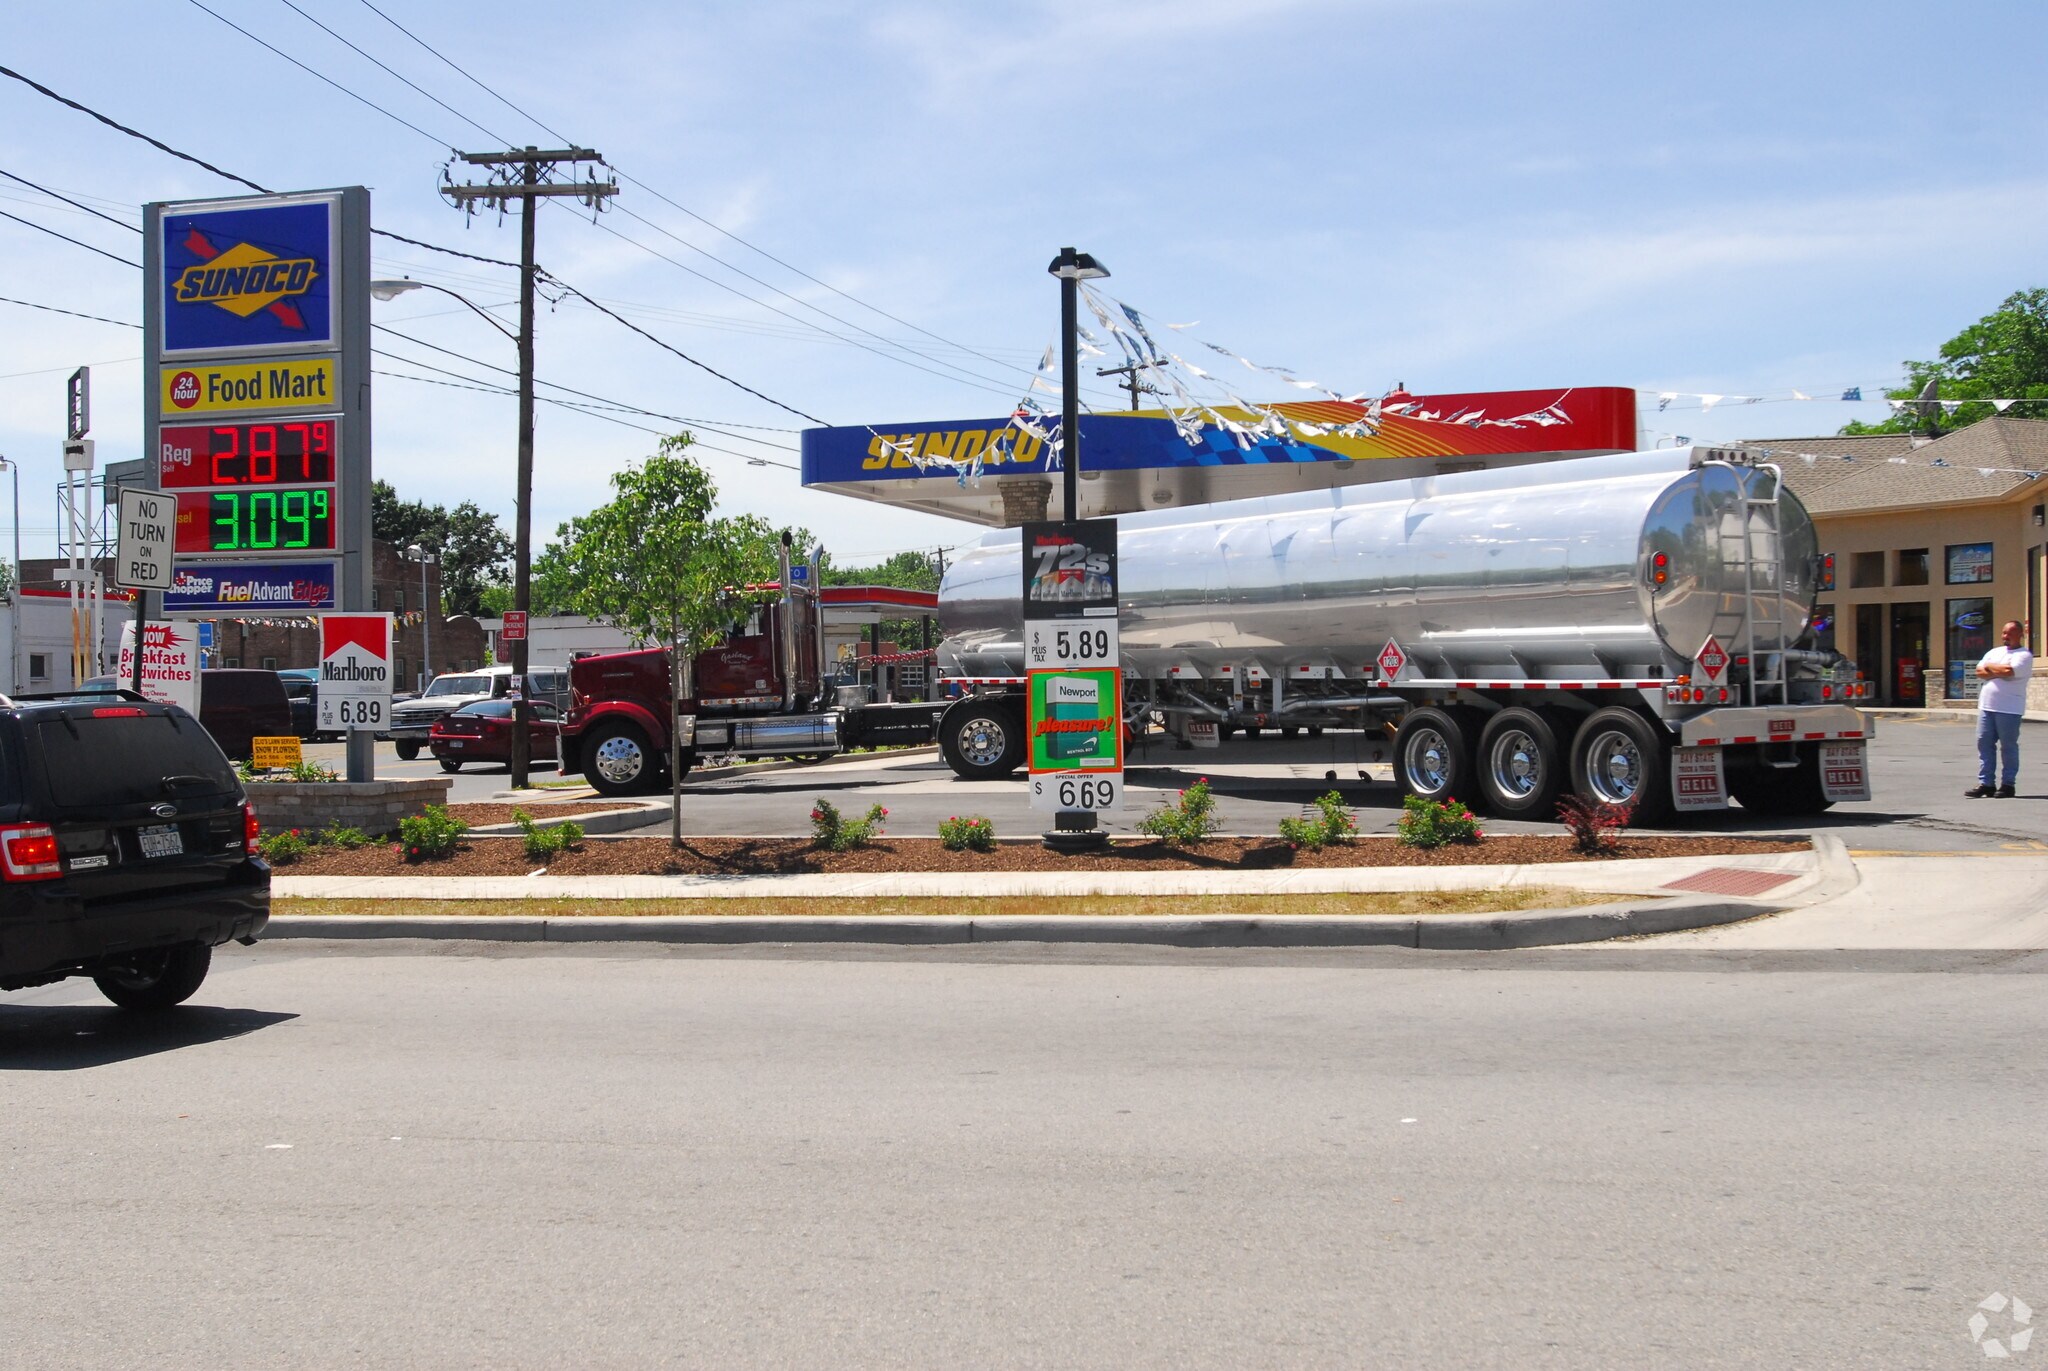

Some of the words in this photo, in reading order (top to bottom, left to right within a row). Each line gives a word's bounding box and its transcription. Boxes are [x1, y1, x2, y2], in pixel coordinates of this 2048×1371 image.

[180, 262, 312, 299] SUNOCO
[179, 377, 193, 389] 24
[208, 370, 262, 402] Food
[269, 367, 326, 399] Mart
[174, 387, 198, 400] hour
[162, 444, 192, 467] Reg
[862, 427, 1043, 470] SUNOCO
[138, 500, 158, 519] NO
[176, 511, 192, 524] sel
[129, 522, 166, 543] TURN
[139, 546, 152, 558] ON
[1032, 543, 1110, 578] 72's
[130, 561, 158, 581] RED
[186, 576, 213, 586] Price
[1033, 632, 1040, 645] $
[1057, 630, 1109, 660] 5.89
[121, 649, 186, 665] Brakfast
[1031, 646, 1047, 655] PLUS
[1033, 654, 1046, 663] TAX
[322, 656, 387, 681] Marlboro
[1384, 656, 1399, 667] 1203
[119, 664, 192, 681] Sadwiches
[1059, 686, 1097, 699] Newport
[323, 700, 329, 711] $
[340, 700, 381, 724] 6.89
[1034, 716, 1114, 737] pleasure!
[1681, 778, 1716, 791] HEIL
[1828, 771, 1860, 783] HEIL
[1035, 781, 1043, 795] $
[1059, 780, 1114, 809] 6.69
